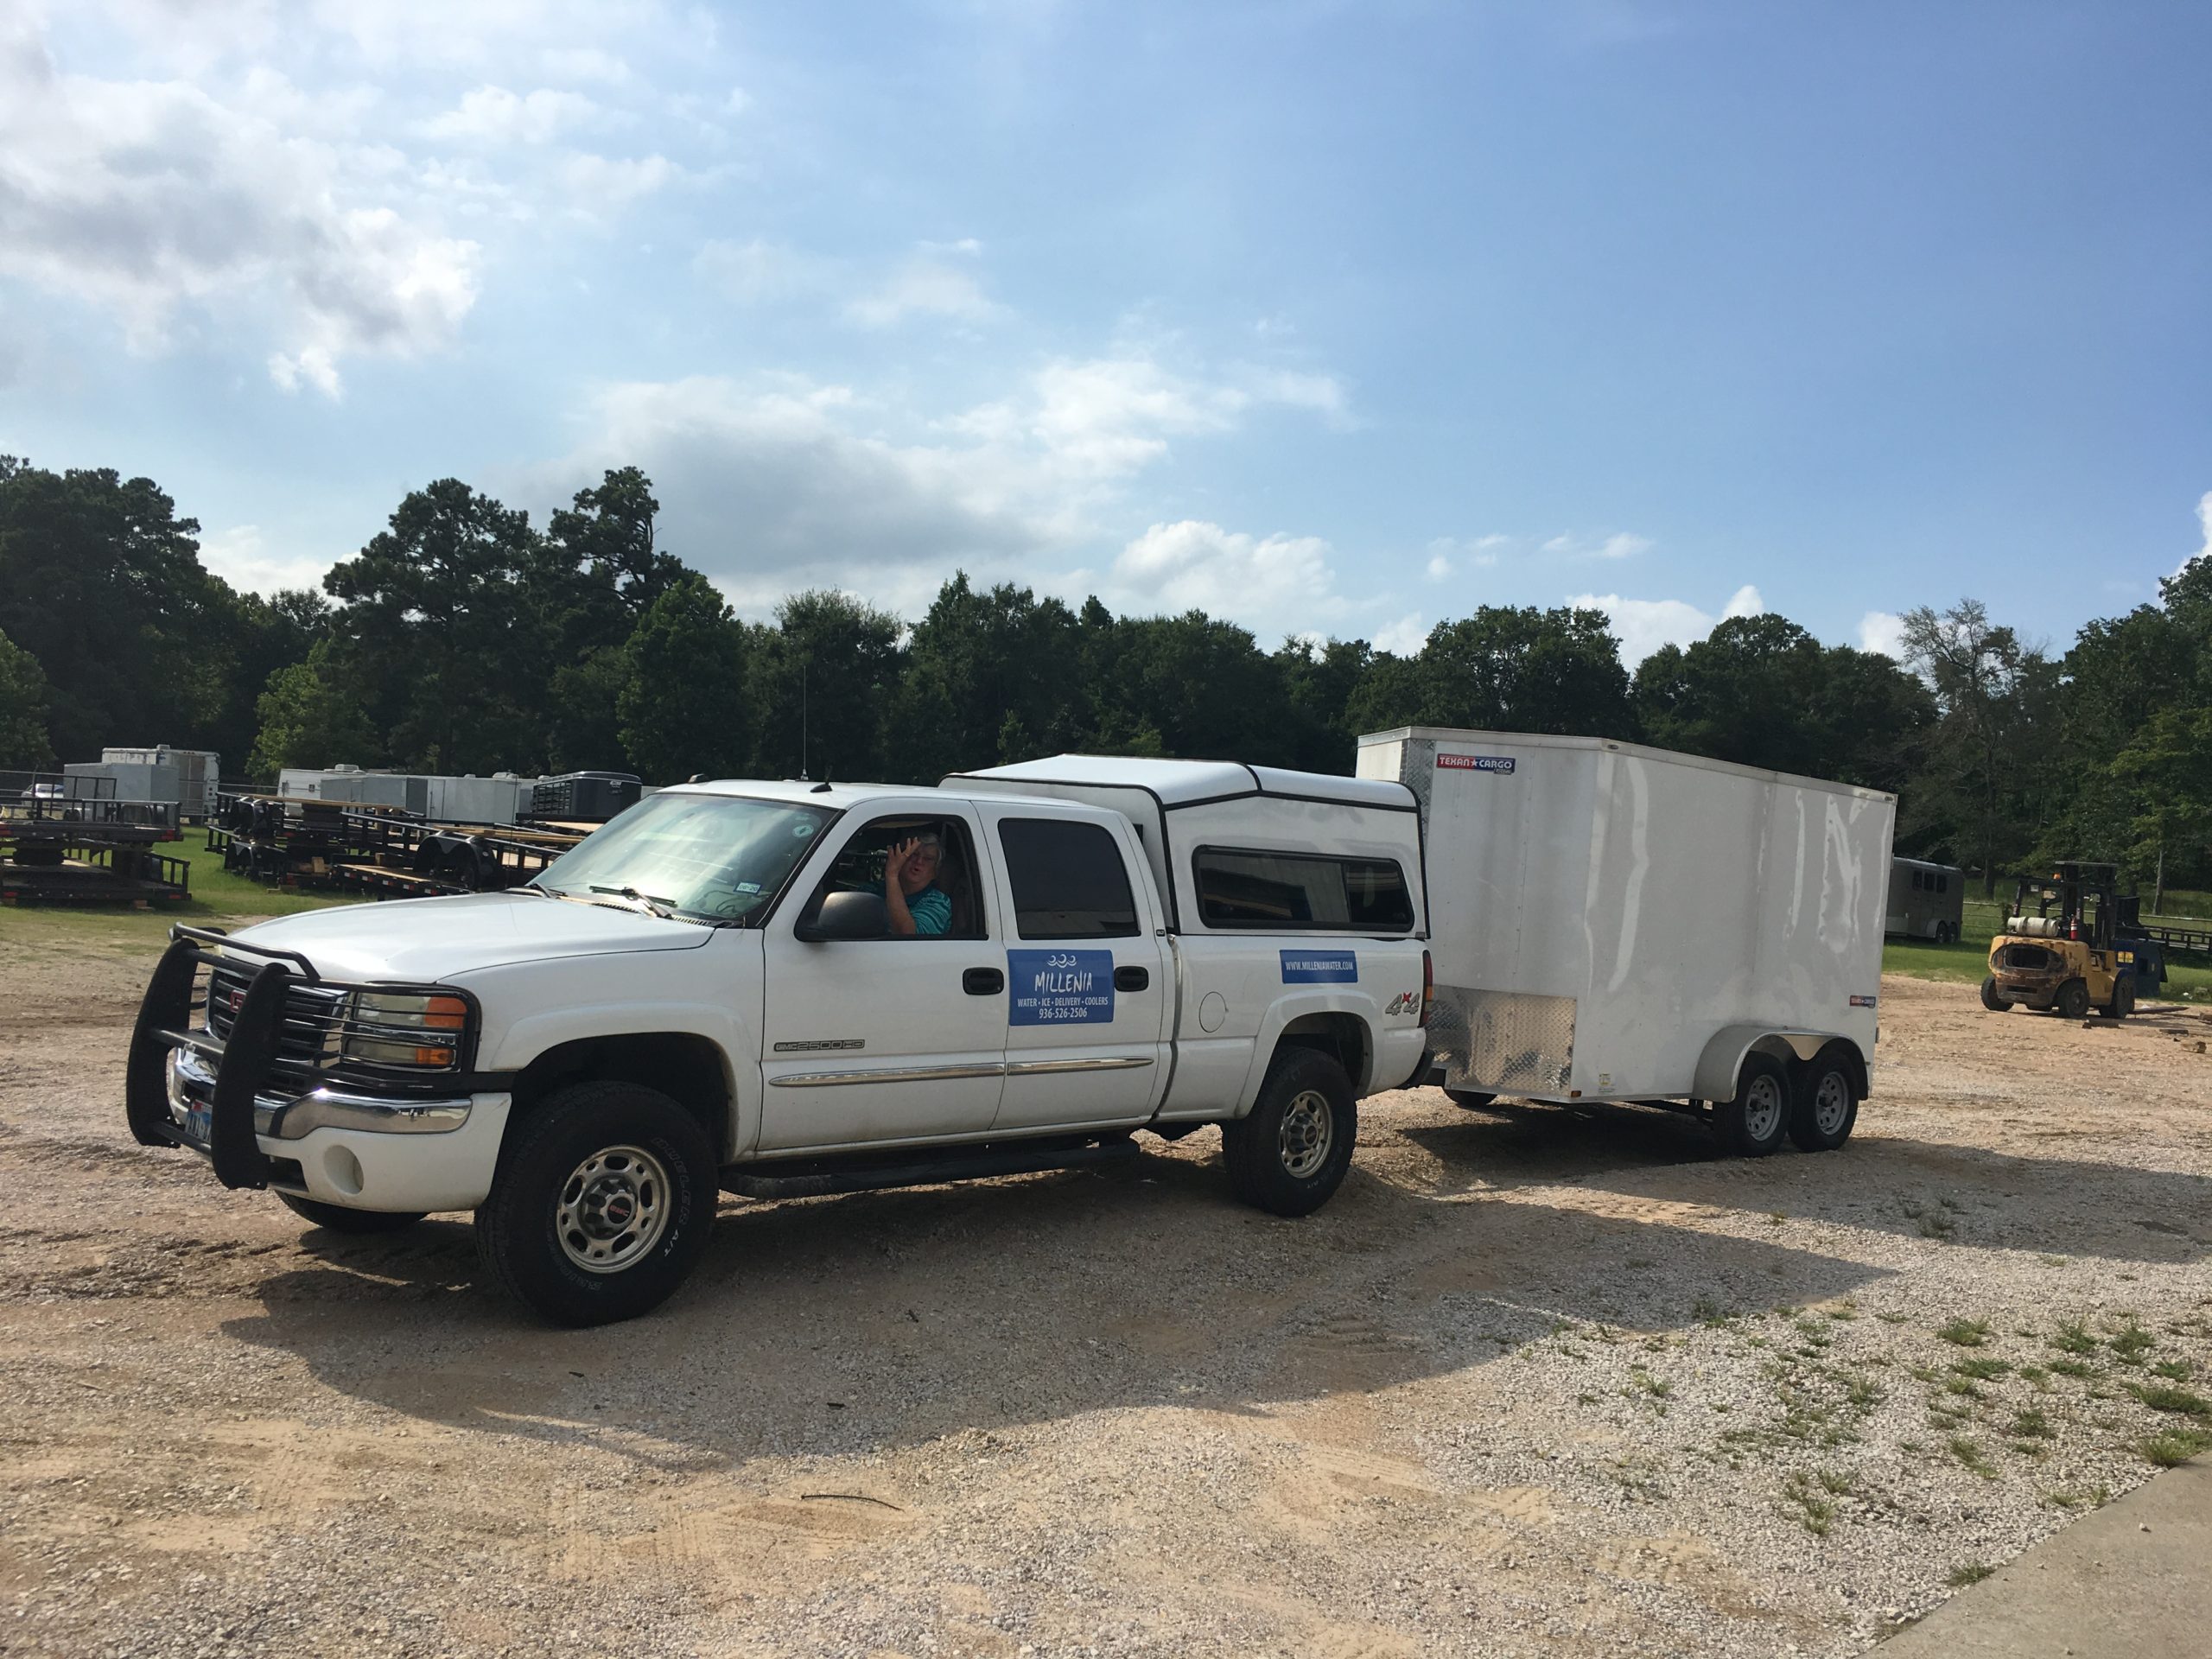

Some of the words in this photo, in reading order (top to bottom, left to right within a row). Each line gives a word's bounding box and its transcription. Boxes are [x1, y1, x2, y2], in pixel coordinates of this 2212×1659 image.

[1439, 756, 1470, 766] TEXAN
[1478, 760, 1512, 769] CARGO
[1285, 961, 1354, 971] WWW.MILLENIAWATER.COM
[1034, 969, 1092, 995] MILLENIA
[1017, 998, 1038, 1007] WATER
[1041, 997, 1051, 1007] ICE
[1054, 997, 1081, 1007] DELIVERY
[1084, 996, 1109, 1006] COOLERS
[1039, 1007, 1088, 1019] 936-526-2506
[664, 1229, 679, 1257] A/T
